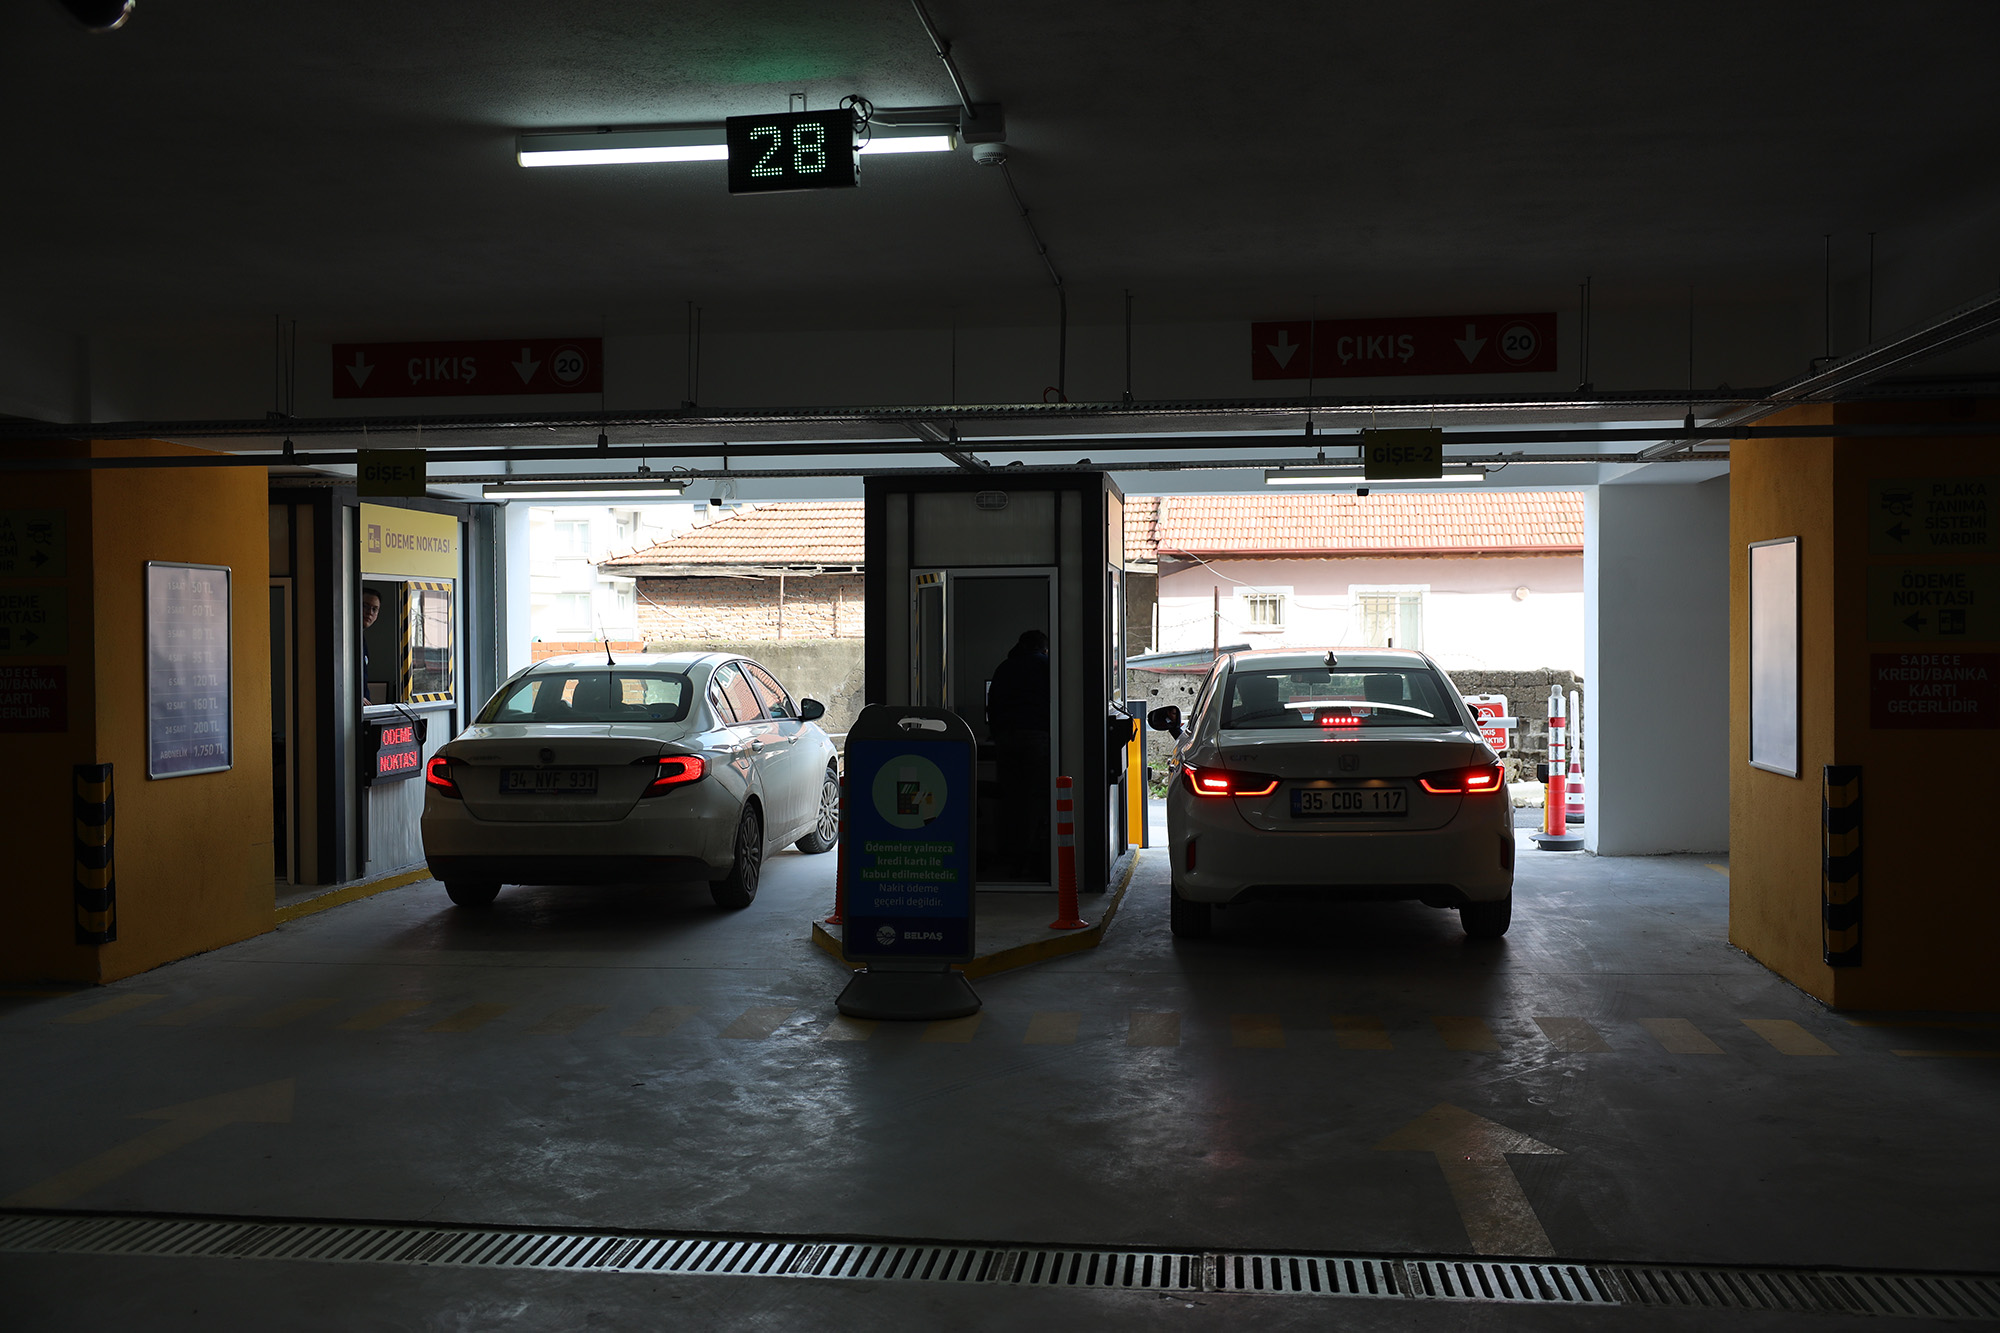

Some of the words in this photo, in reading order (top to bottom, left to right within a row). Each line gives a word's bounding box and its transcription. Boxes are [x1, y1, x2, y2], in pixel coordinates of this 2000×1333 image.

[749, 122, 826, 178] 28
[1336, 334, 1415, 365] ÇIKIŞ
[1506, 335, 1532, 351] 20
[408, 356, 477, 385] ÇIKIŞ
[557, 358, 581, 374] 20
[1373, 443, 1433, 466] GİŞE-2
[365, 462, 416, 485] GİŞE-1
[1932, 483, 1987, 497] PLAKA
[1927, 500, 1987, 513] TANIMA
[1925, 513, 1987, 530] SİSTEMİ
[385, 528, 414, 550] ÖDEME
[416, 536, 450, 553] NOKTASI
[1929, 532, 1987, 545] VARDIR
[1901, 570, 1966, 588] ÖDEME
[202, 582, 214, 594] TL
[1893, 591, 1974, 606] NOKTASI
[0, 610, 46, 624] KTASI
[204, 605, 215, 617] TL
[204, 628, 215, 640] TL
[203, 651, 214, 663] TL
[1900, 655, 1961, 666] SADECE
[1878, 664, 1988, 681] KREDİ/BANKA
[208, 674, 218, 687] TL
[1908, 684, 1957, 697] KARTI
[209, 697, 219, 709] TL
[1887, 697, 1979, 717] GEÇERLİDİR
[193, 721, 209, 734] 200
[210, 720, 220, 733] TL
[193, 743, 214, 757] 1.750
[215, 743, 225, 755] TL
[380, 751, 418, 772] NOKTASI
[511, 772, 527, 787] 34
[536, 772, 560, 788] NVF
[569, 772, 594, 787] 931
[1303, 792, 1323, 810] 35
[1332, 792, 1363, 810] CDG
[1372, 792, 1402, 809] 117
[865, 841, 911, 853] Ödemeler
[914, 843, 953, 855] yalnızca
[877, 856, 902, 866] kredi
[904, 856, 927, 866] kartı
[929, 856, 942, 866] ile
[862, 869, 890, 879] kabul
[892, 869, 956, 880] edilmektedir.
[879, 883, 905, 893] Nakit
[907, 883, 940, 893] ödeme
[874, 896, 904, 908] geçerli
[906, 897, 944, 909] değildir.
[904, 931, 944, 942] BELPAŞ
